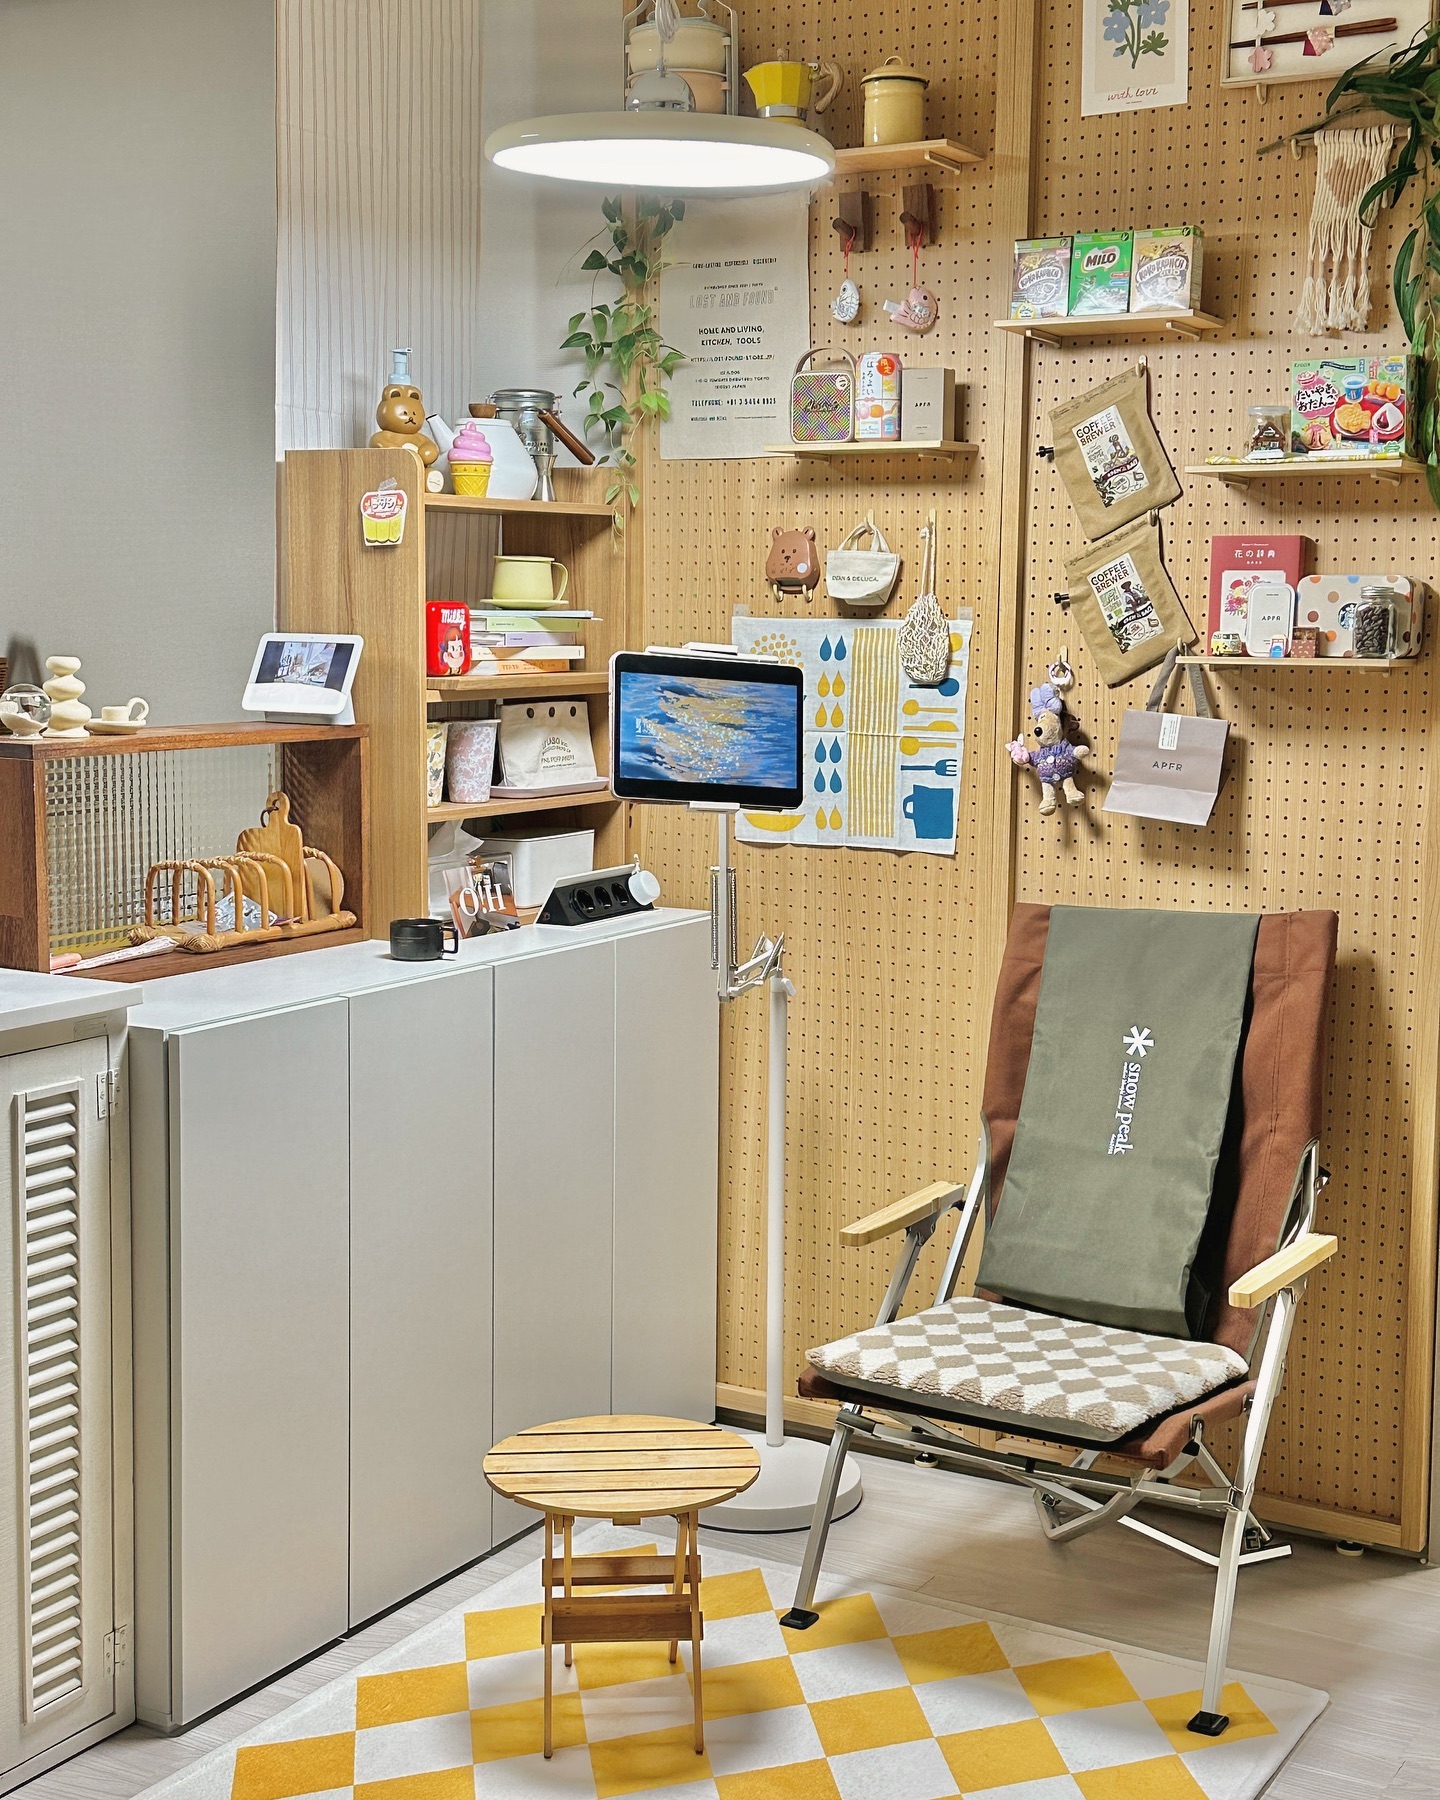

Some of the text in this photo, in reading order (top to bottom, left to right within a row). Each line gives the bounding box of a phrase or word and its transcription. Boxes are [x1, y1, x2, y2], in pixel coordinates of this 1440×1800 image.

[1107, 86, 1159, 101] with love
[1085, 252, 1117, 268] MILO
[689, 289, 775, 309] LOST AND FOUND
[698, 325, 765, 335] HOME AND LIVING,
[701, 336, 761, 346] KITCHEN, TOOLS
[866, 360, 875, 396] ほろよい
[1076, 411, 1114, 440] COFFEE
[1079, 421, 1117, 447] BREWER
[1090, 560, 1128, 587] COFFEE
[1094, 568, 1131, 594] BREWER
[1152, 760, 1184, 772] APFR
[1123, 1061, 1142, 1111] snow
[1113, 1110, 1135, 1156] peak
